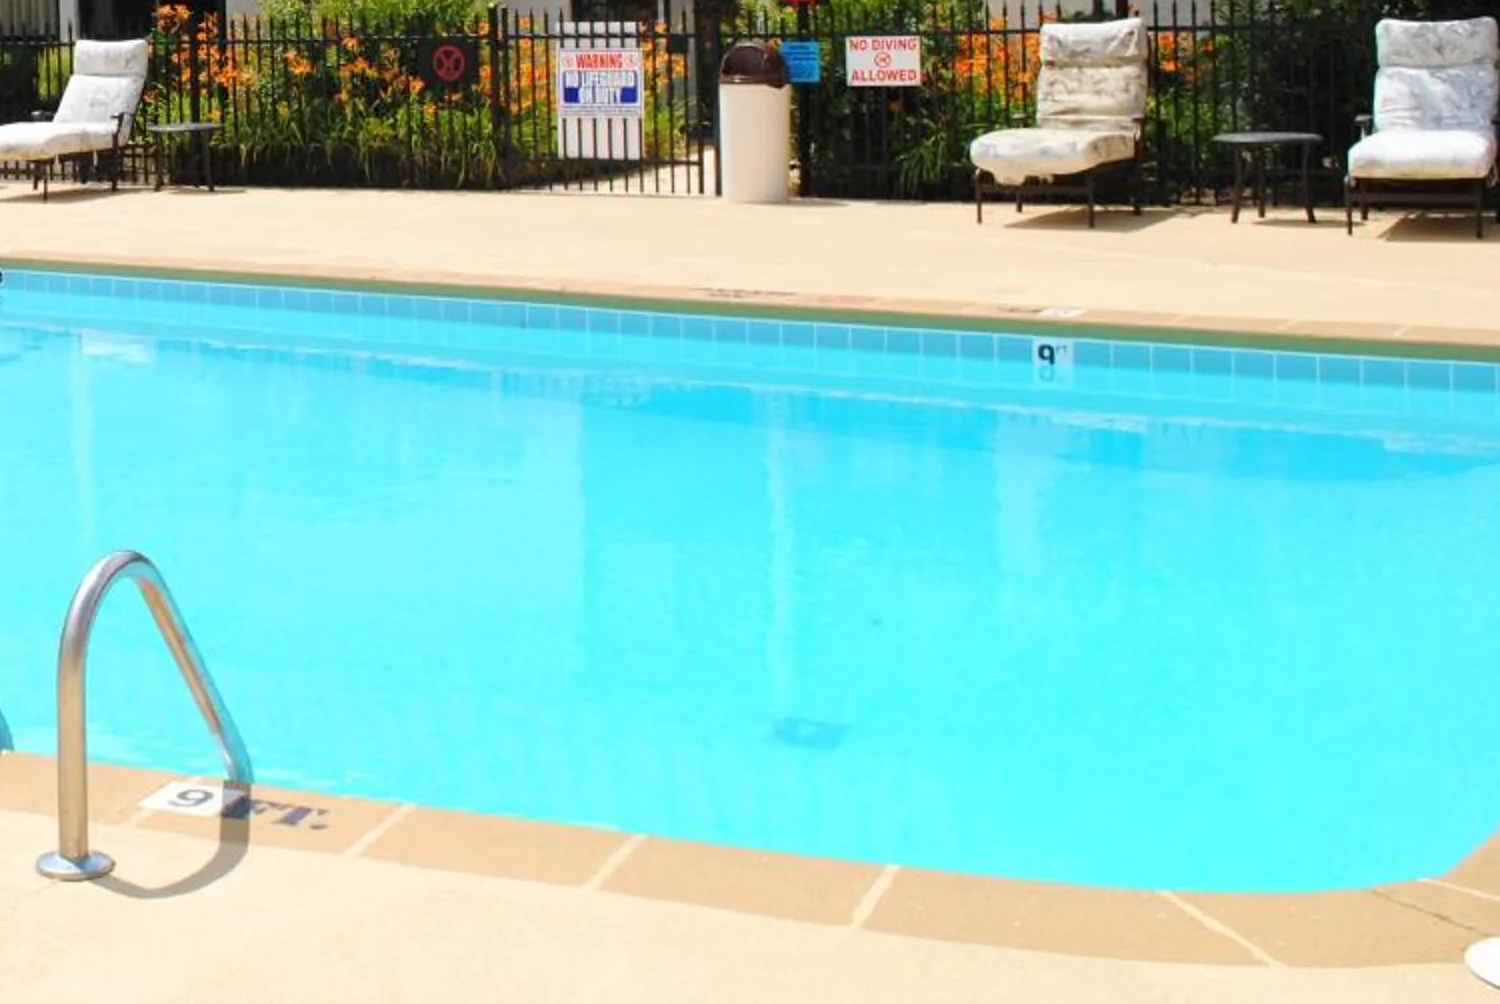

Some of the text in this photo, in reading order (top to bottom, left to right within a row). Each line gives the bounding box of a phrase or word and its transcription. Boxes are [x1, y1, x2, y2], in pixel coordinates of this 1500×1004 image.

[850, 39, 917, 51] NO DIVING
[576, 53, 622, 69] WARNING
[851, 70, 917, 82] ALLOWED
[1037, 343, 1055, 365] 9
[166, 788, 214, 808] 9
